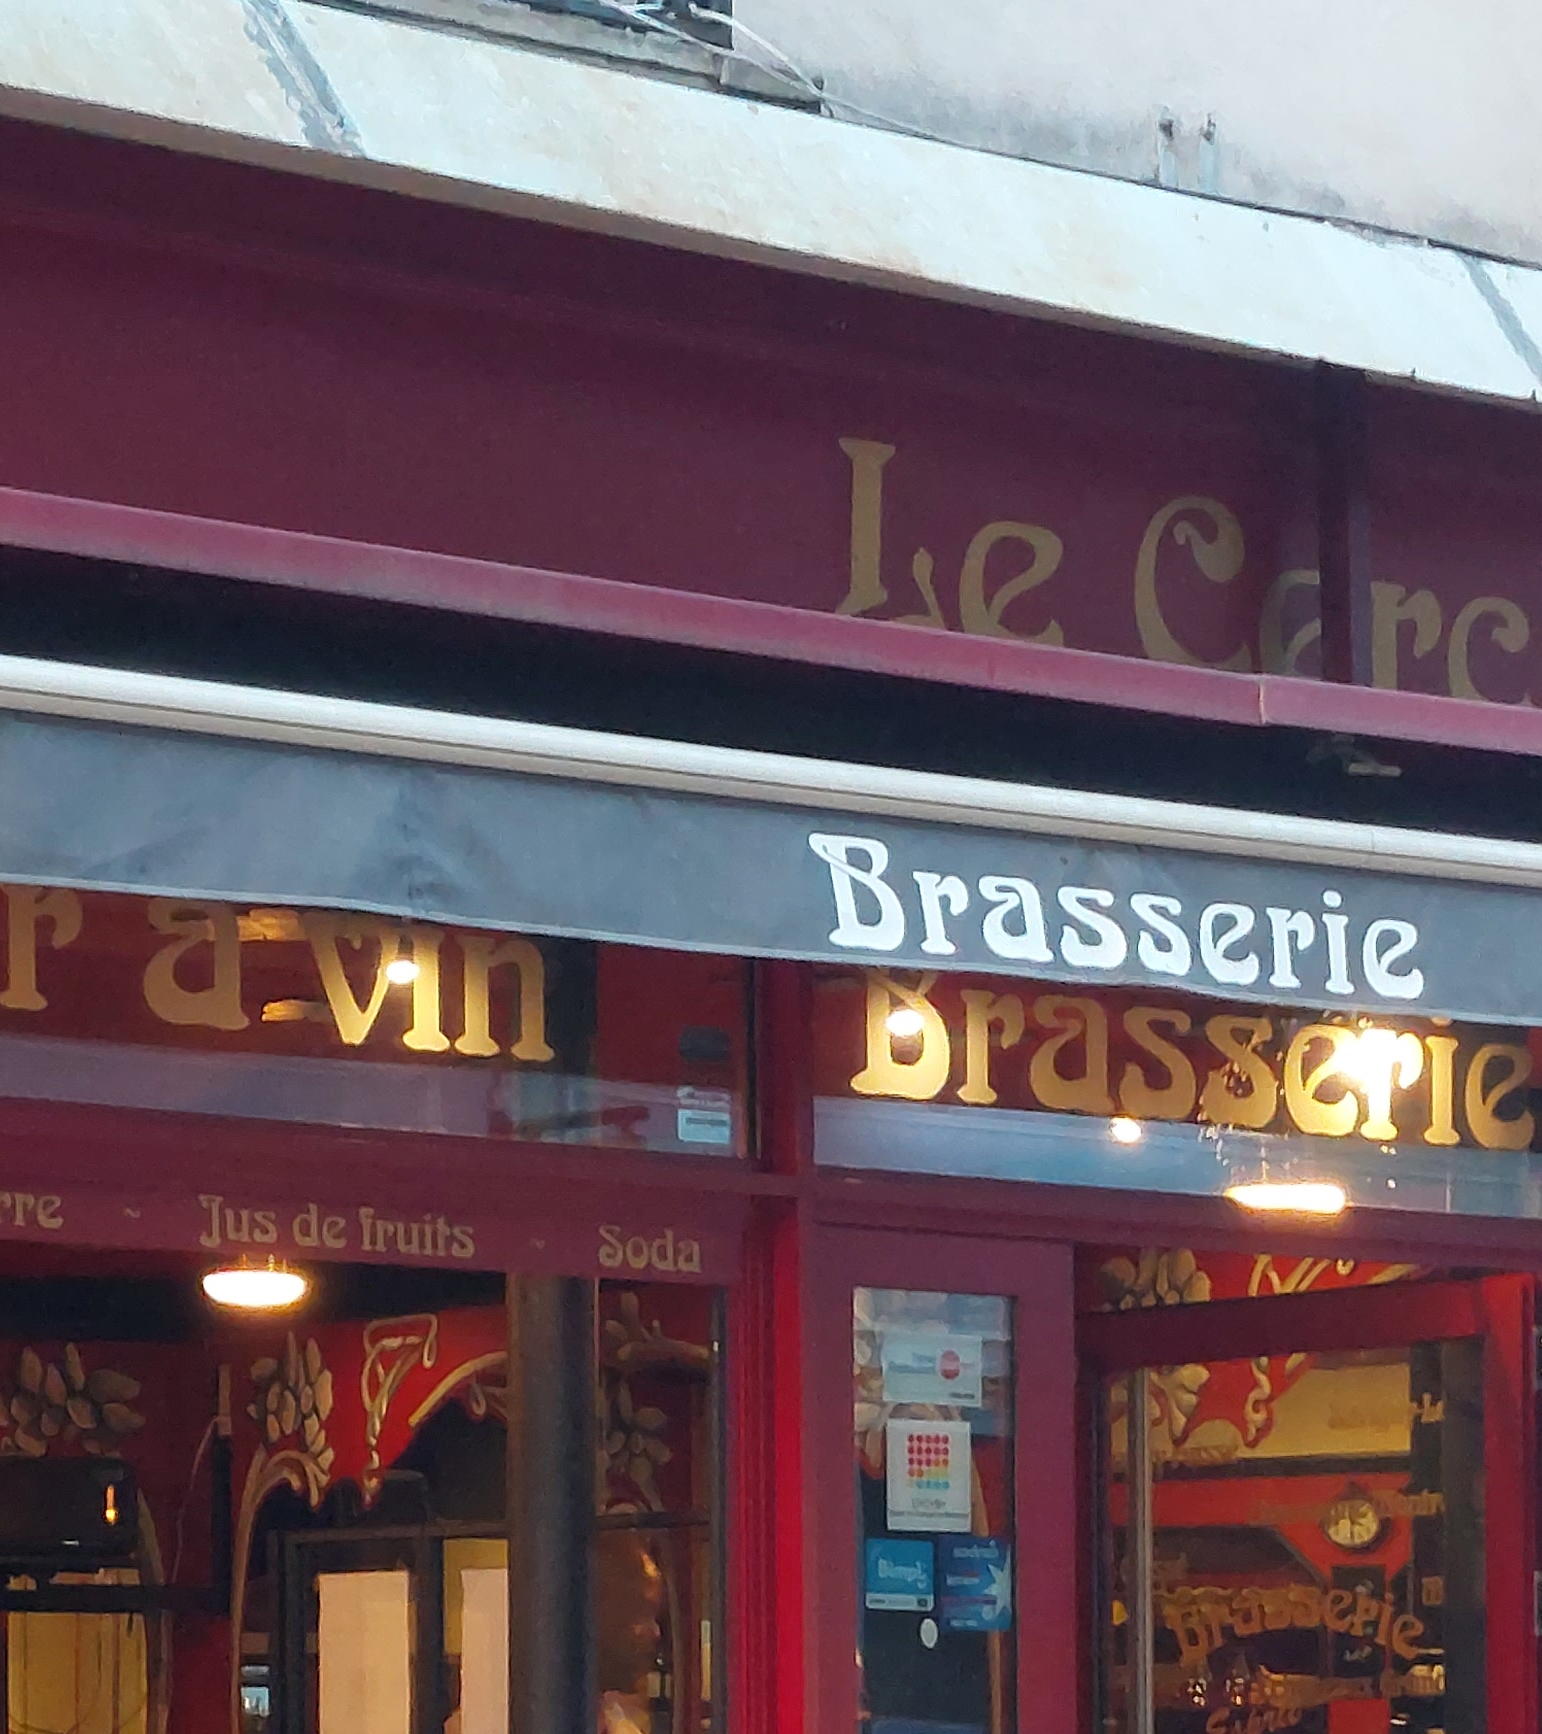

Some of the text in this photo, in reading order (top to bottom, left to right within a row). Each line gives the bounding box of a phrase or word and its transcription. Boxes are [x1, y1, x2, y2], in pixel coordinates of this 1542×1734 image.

[835, 437, 1064, 650] Le
[305, 912, 556, 1062] vin
[808, 832, 1425, 1000] Brasserie
[849, 969, 1535, 1150] Brasserie
[198, 1194, 475, 1259] Jus de fruits
[598, 1224, 702, 1274] Soda
